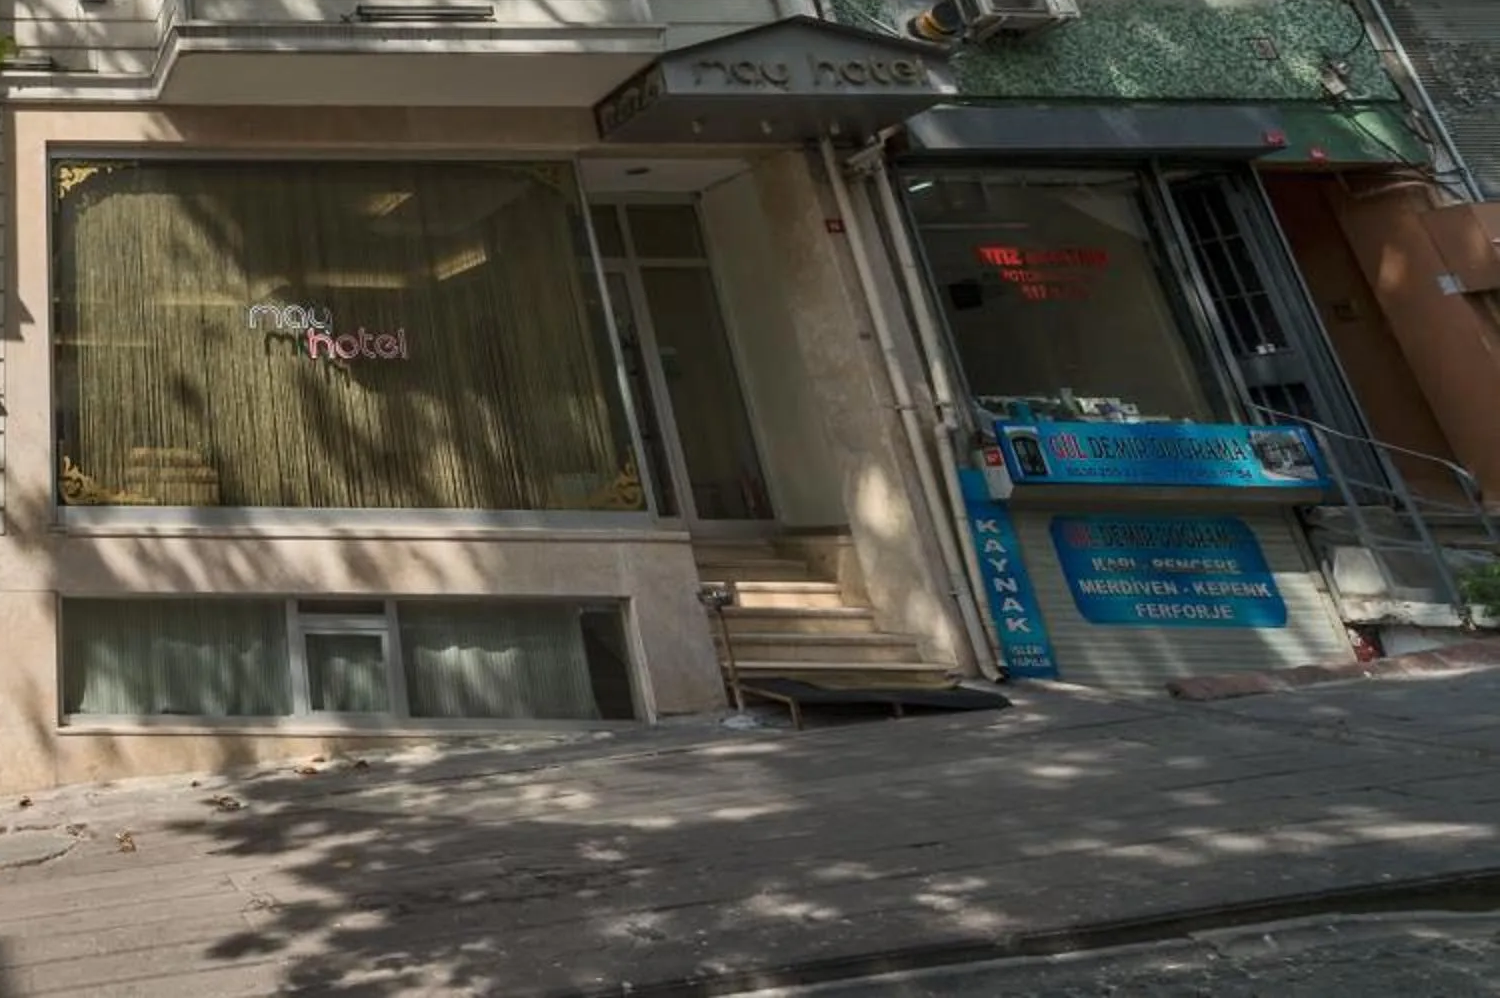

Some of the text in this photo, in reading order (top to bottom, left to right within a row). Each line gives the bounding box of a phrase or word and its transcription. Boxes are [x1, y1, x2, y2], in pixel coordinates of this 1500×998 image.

[249, 304, 333, 335] may
[305, 327, 408, 360] hotel
[975, 519, 1032, 633] KAYNAK
[1077, 577, 1273, 598] MERDİVEN KEPENK
[1134, 603, 1235, 620] FERFORJE
